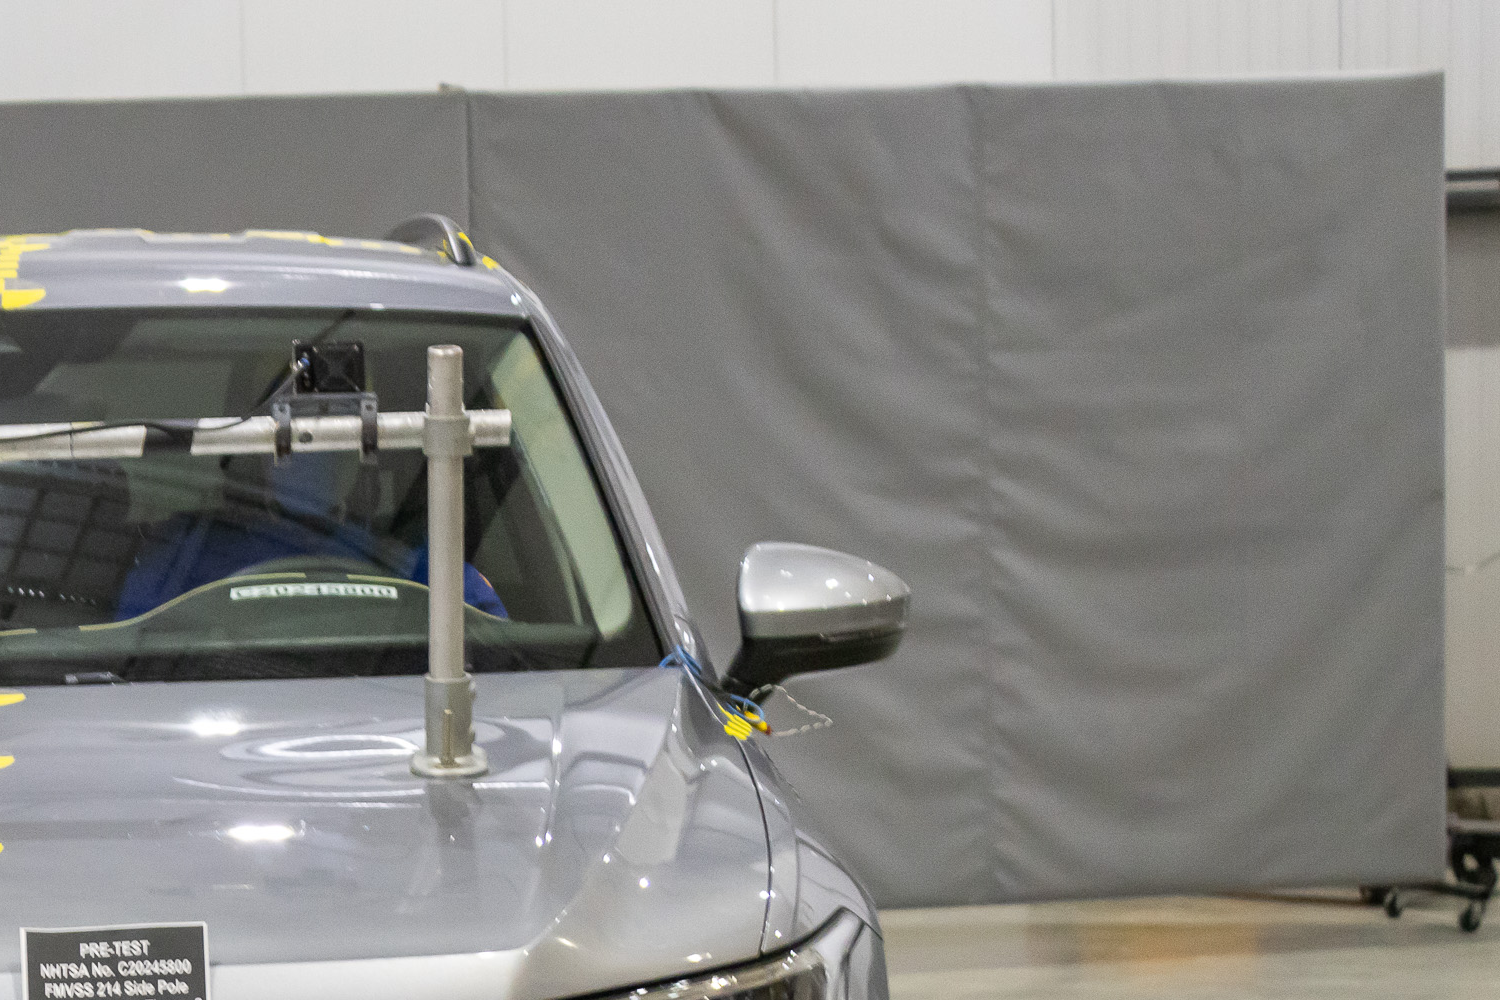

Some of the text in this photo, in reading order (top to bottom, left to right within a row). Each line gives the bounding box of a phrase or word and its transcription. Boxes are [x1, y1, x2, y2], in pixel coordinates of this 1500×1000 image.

[80, 939, 150, 958] PRE-TEST
[40, 963, 90, 979] NHTSA
[92, 962, 115, 977] No.
[45, 979, 189, 998] FMVSS 214 Side Pole
